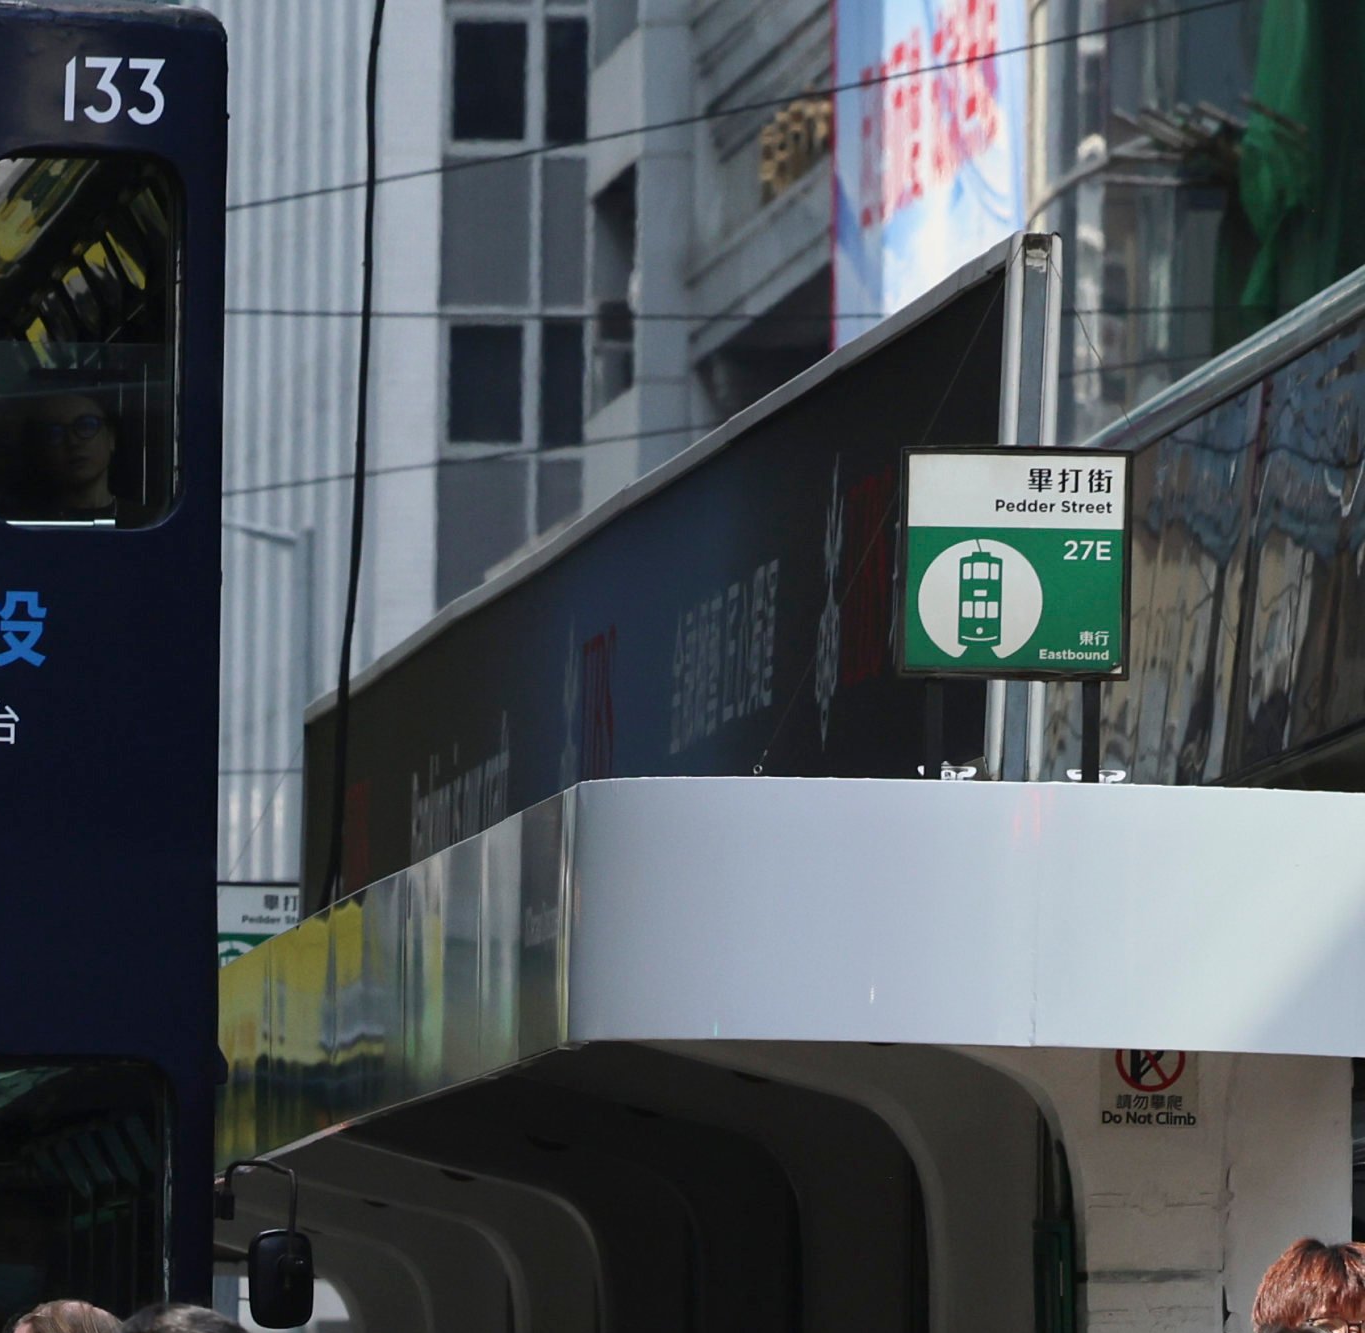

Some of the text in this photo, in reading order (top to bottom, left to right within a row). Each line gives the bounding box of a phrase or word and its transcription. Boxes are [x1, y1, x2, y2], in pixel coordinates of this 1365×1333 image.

[64, 56, 167, 125] 133
[1027, 468, 1113, 494] 畢打街
[995, 500, 1113, 514] Pedder Street
[1063, 540, 1112, 561] 27E
[1079, 631, 1110, 646] 東行
[1038, 649, 1110, 662] Eastbound
[1101, 1110, 1197, 1126] Do Not Climb
